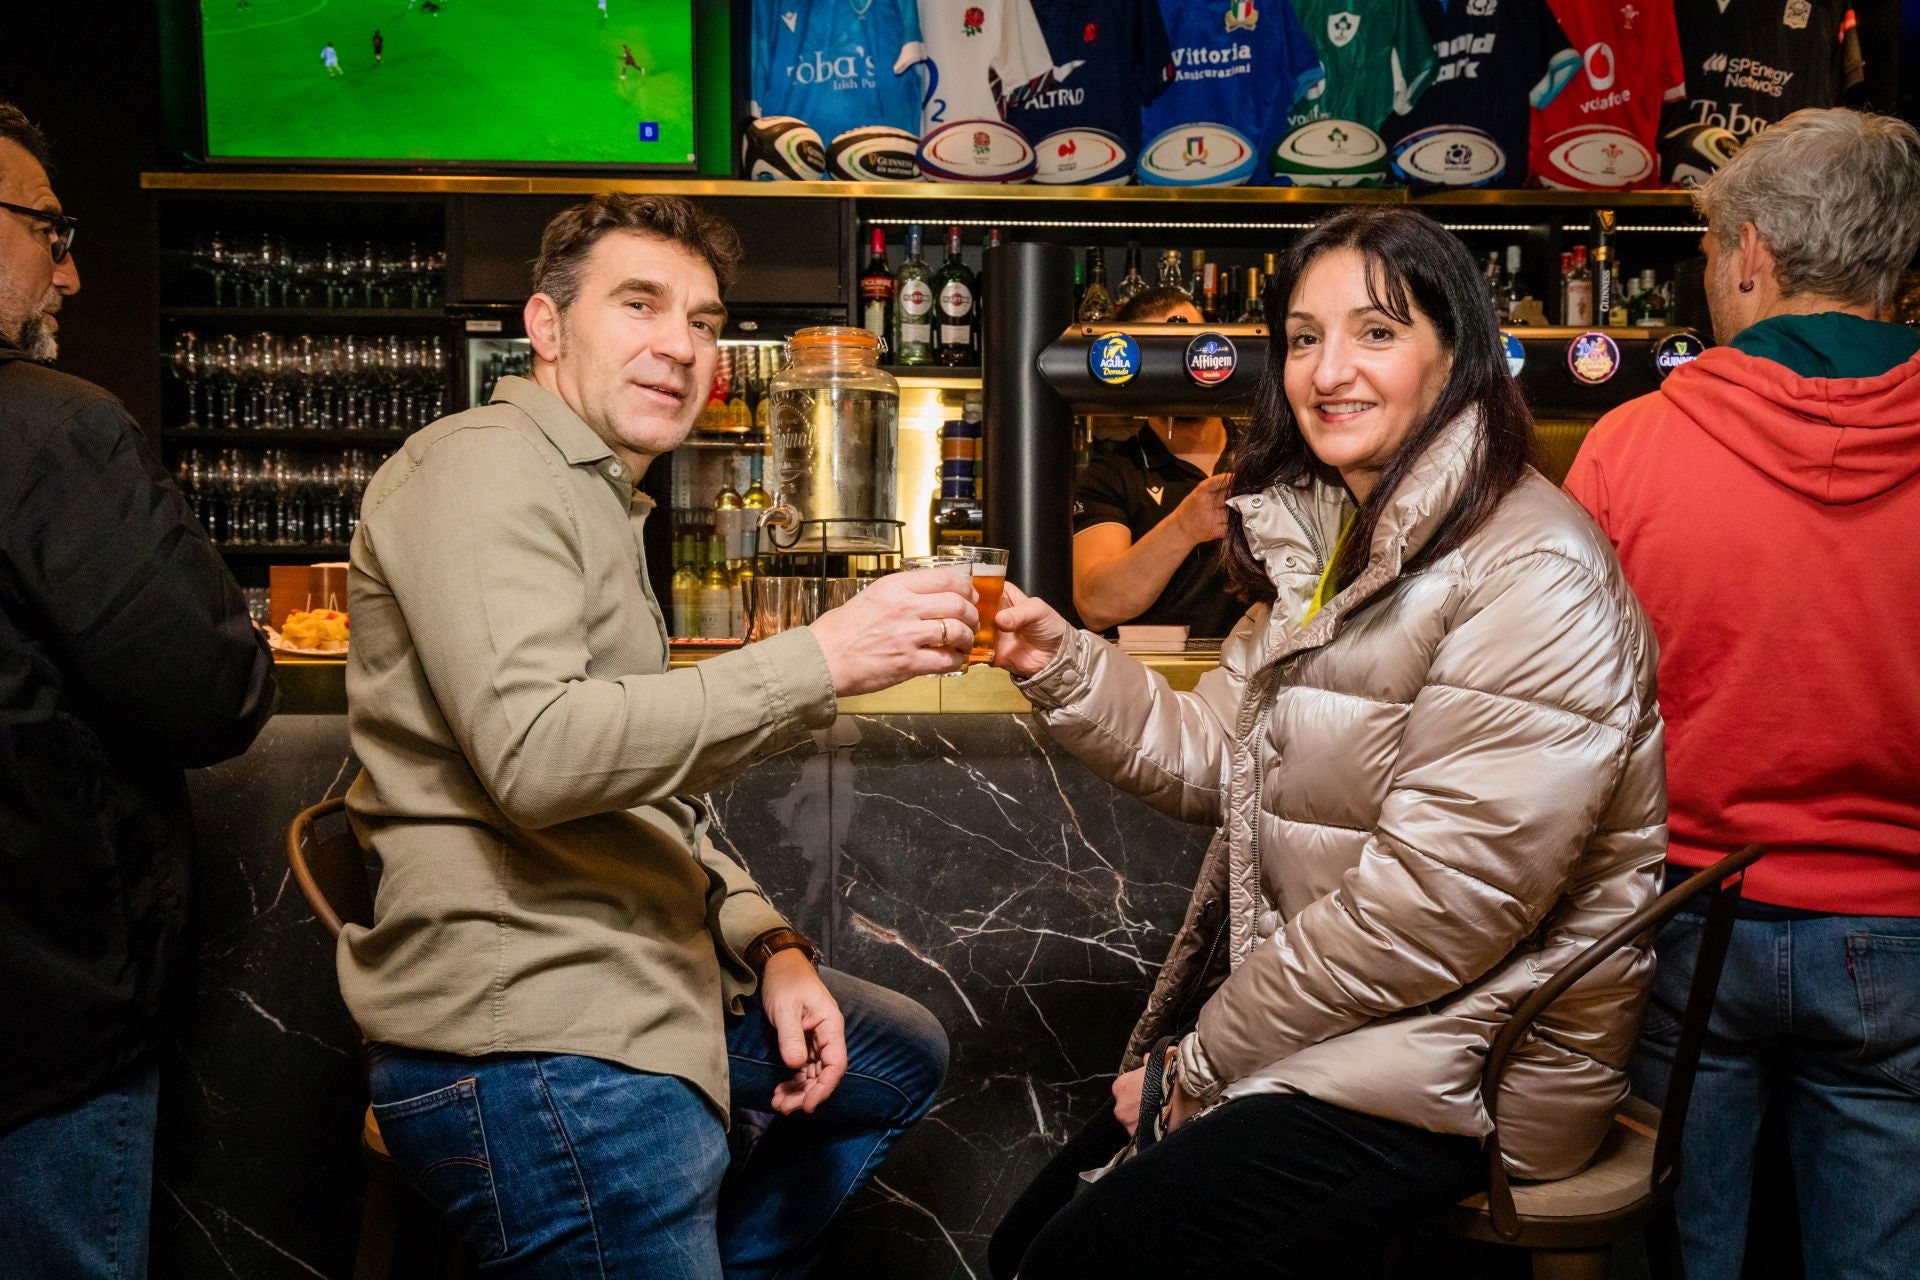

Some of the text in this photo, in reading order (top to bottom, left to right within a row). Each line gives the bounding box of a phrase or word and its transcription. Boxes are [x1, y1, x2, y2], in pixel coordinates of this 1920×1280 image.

[1171, 43, 1252, 67] Vittoria
[877, 156, 913, 169] GUINNESS
[1600, 269, 1611, 312] GUINNESS
[1190, 355, 1233, 370] Affligem
[1658, 355, 1698, 367] GUINN
